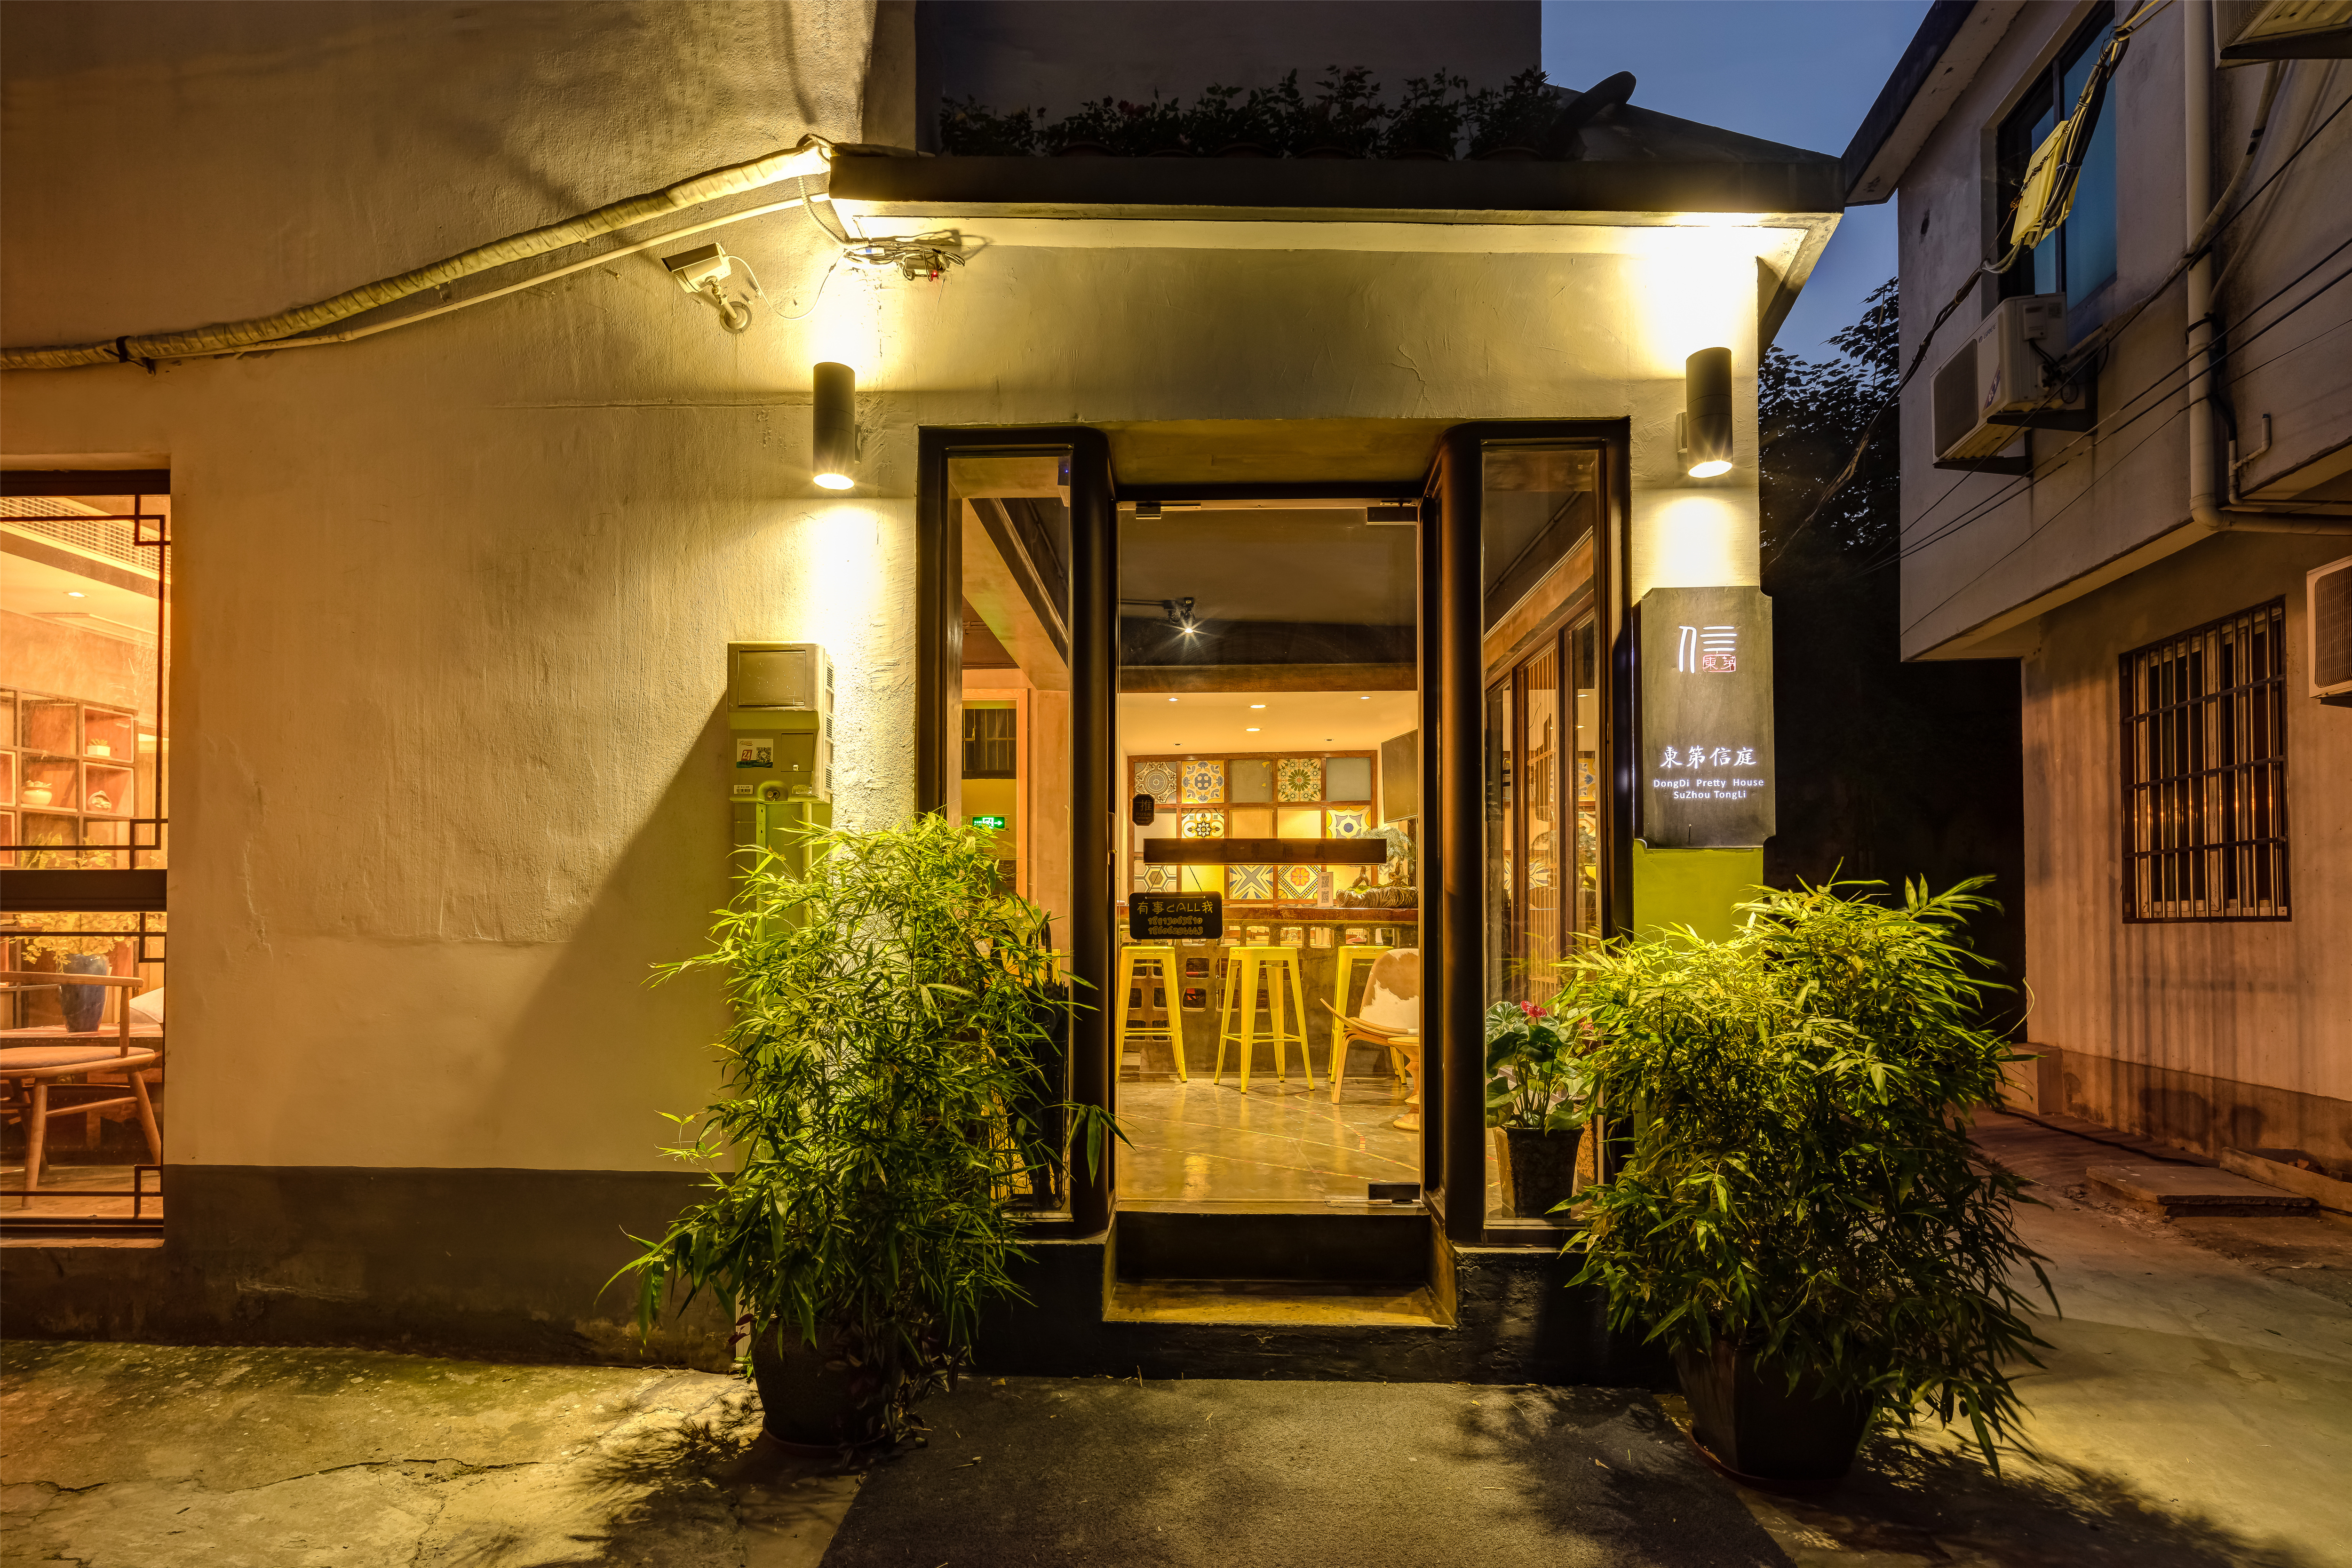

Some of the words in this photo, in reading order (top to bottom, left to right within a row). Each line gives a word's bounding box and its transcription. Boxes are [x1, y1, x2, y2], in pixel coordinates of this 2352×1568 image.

[1660, 745, 1757, 769] 東第信庭
[1653, 779, 1690, 788] DongDi
[1696, 779, 1726, 788] Pretty
[1674, 790, 1710, 799] SuZhou
[1714, 790, 1747, 800] TongLi
[1138, 799, 1152, 812] 推
